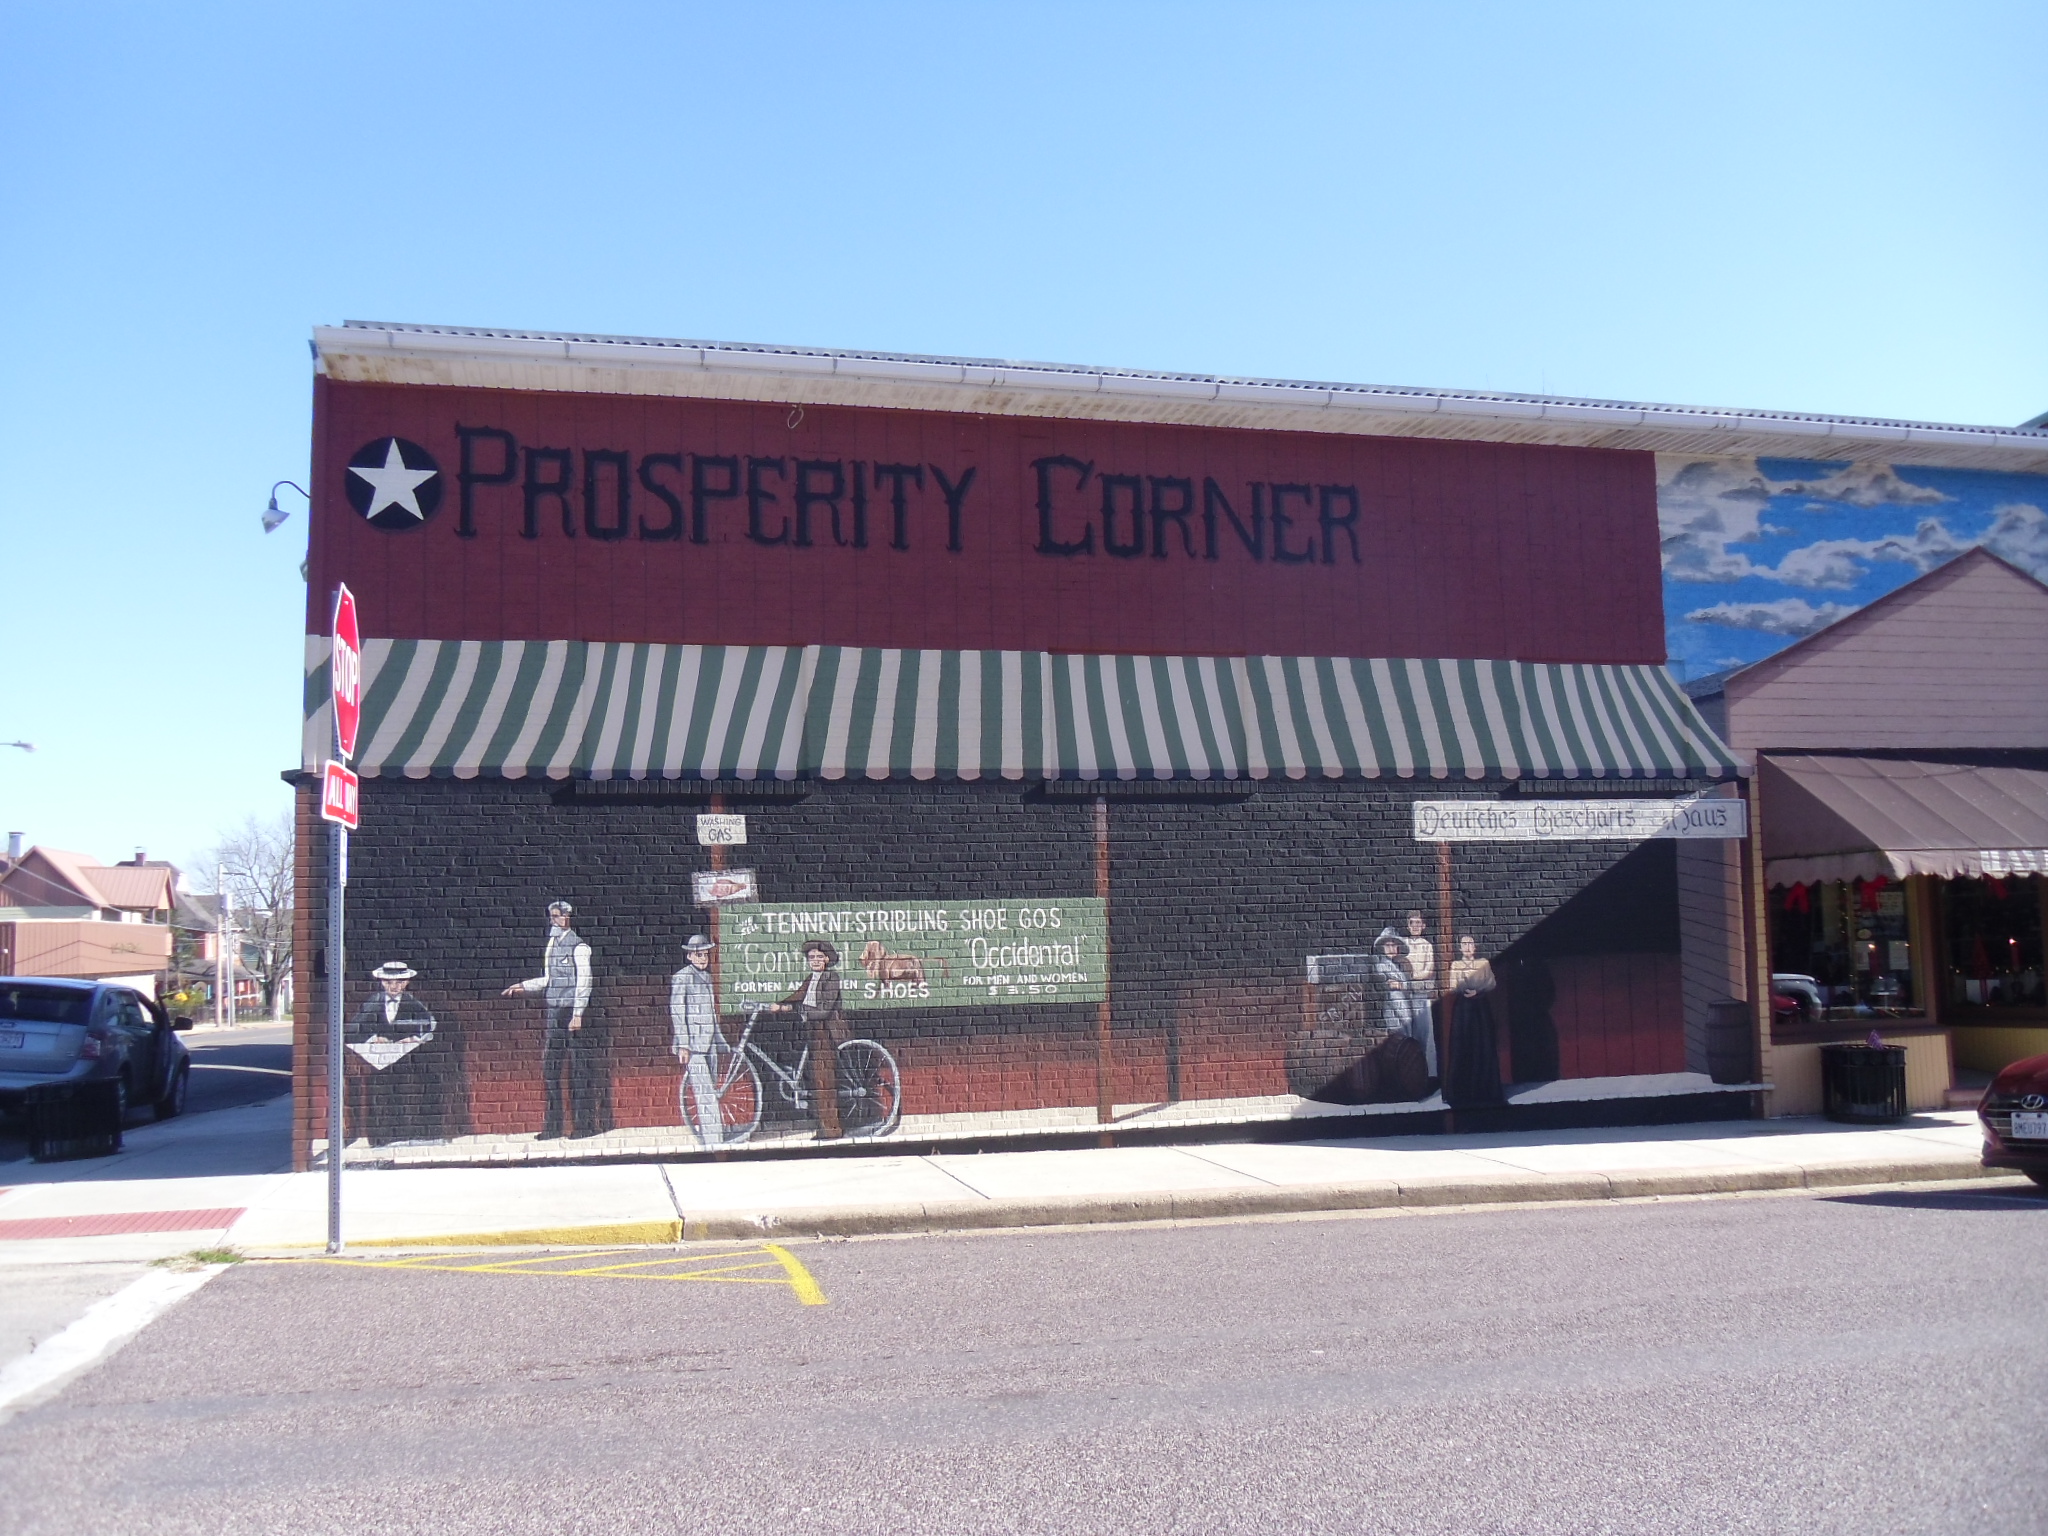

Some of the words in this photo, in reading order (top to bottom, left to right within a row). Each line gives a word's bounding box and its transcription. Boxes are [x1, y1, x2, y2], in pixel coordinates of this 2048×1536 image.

[453, 424, 977, 552] PROSPERITY
[1030, 454, 1362, 565] CORNER
[334, 633, 358, 707] STOP
[326, 774, 344, 810] ALL
[700, 816, 742, 827] WASHING
[708, 827, 733, 842] GAS
[959, 908, 1008, 931] SHOE
[734, 981, 757, 993] FOR
[758, 980, 782, 992] MEN
[963, 976, 985, 985] FOR
[987, 974, 1010, 985] MEN
[1016, 974, 1038, 984] AND
[1041, 972, 1088, 983] WOMEN
[863, 981, 930, 999] SHOES
